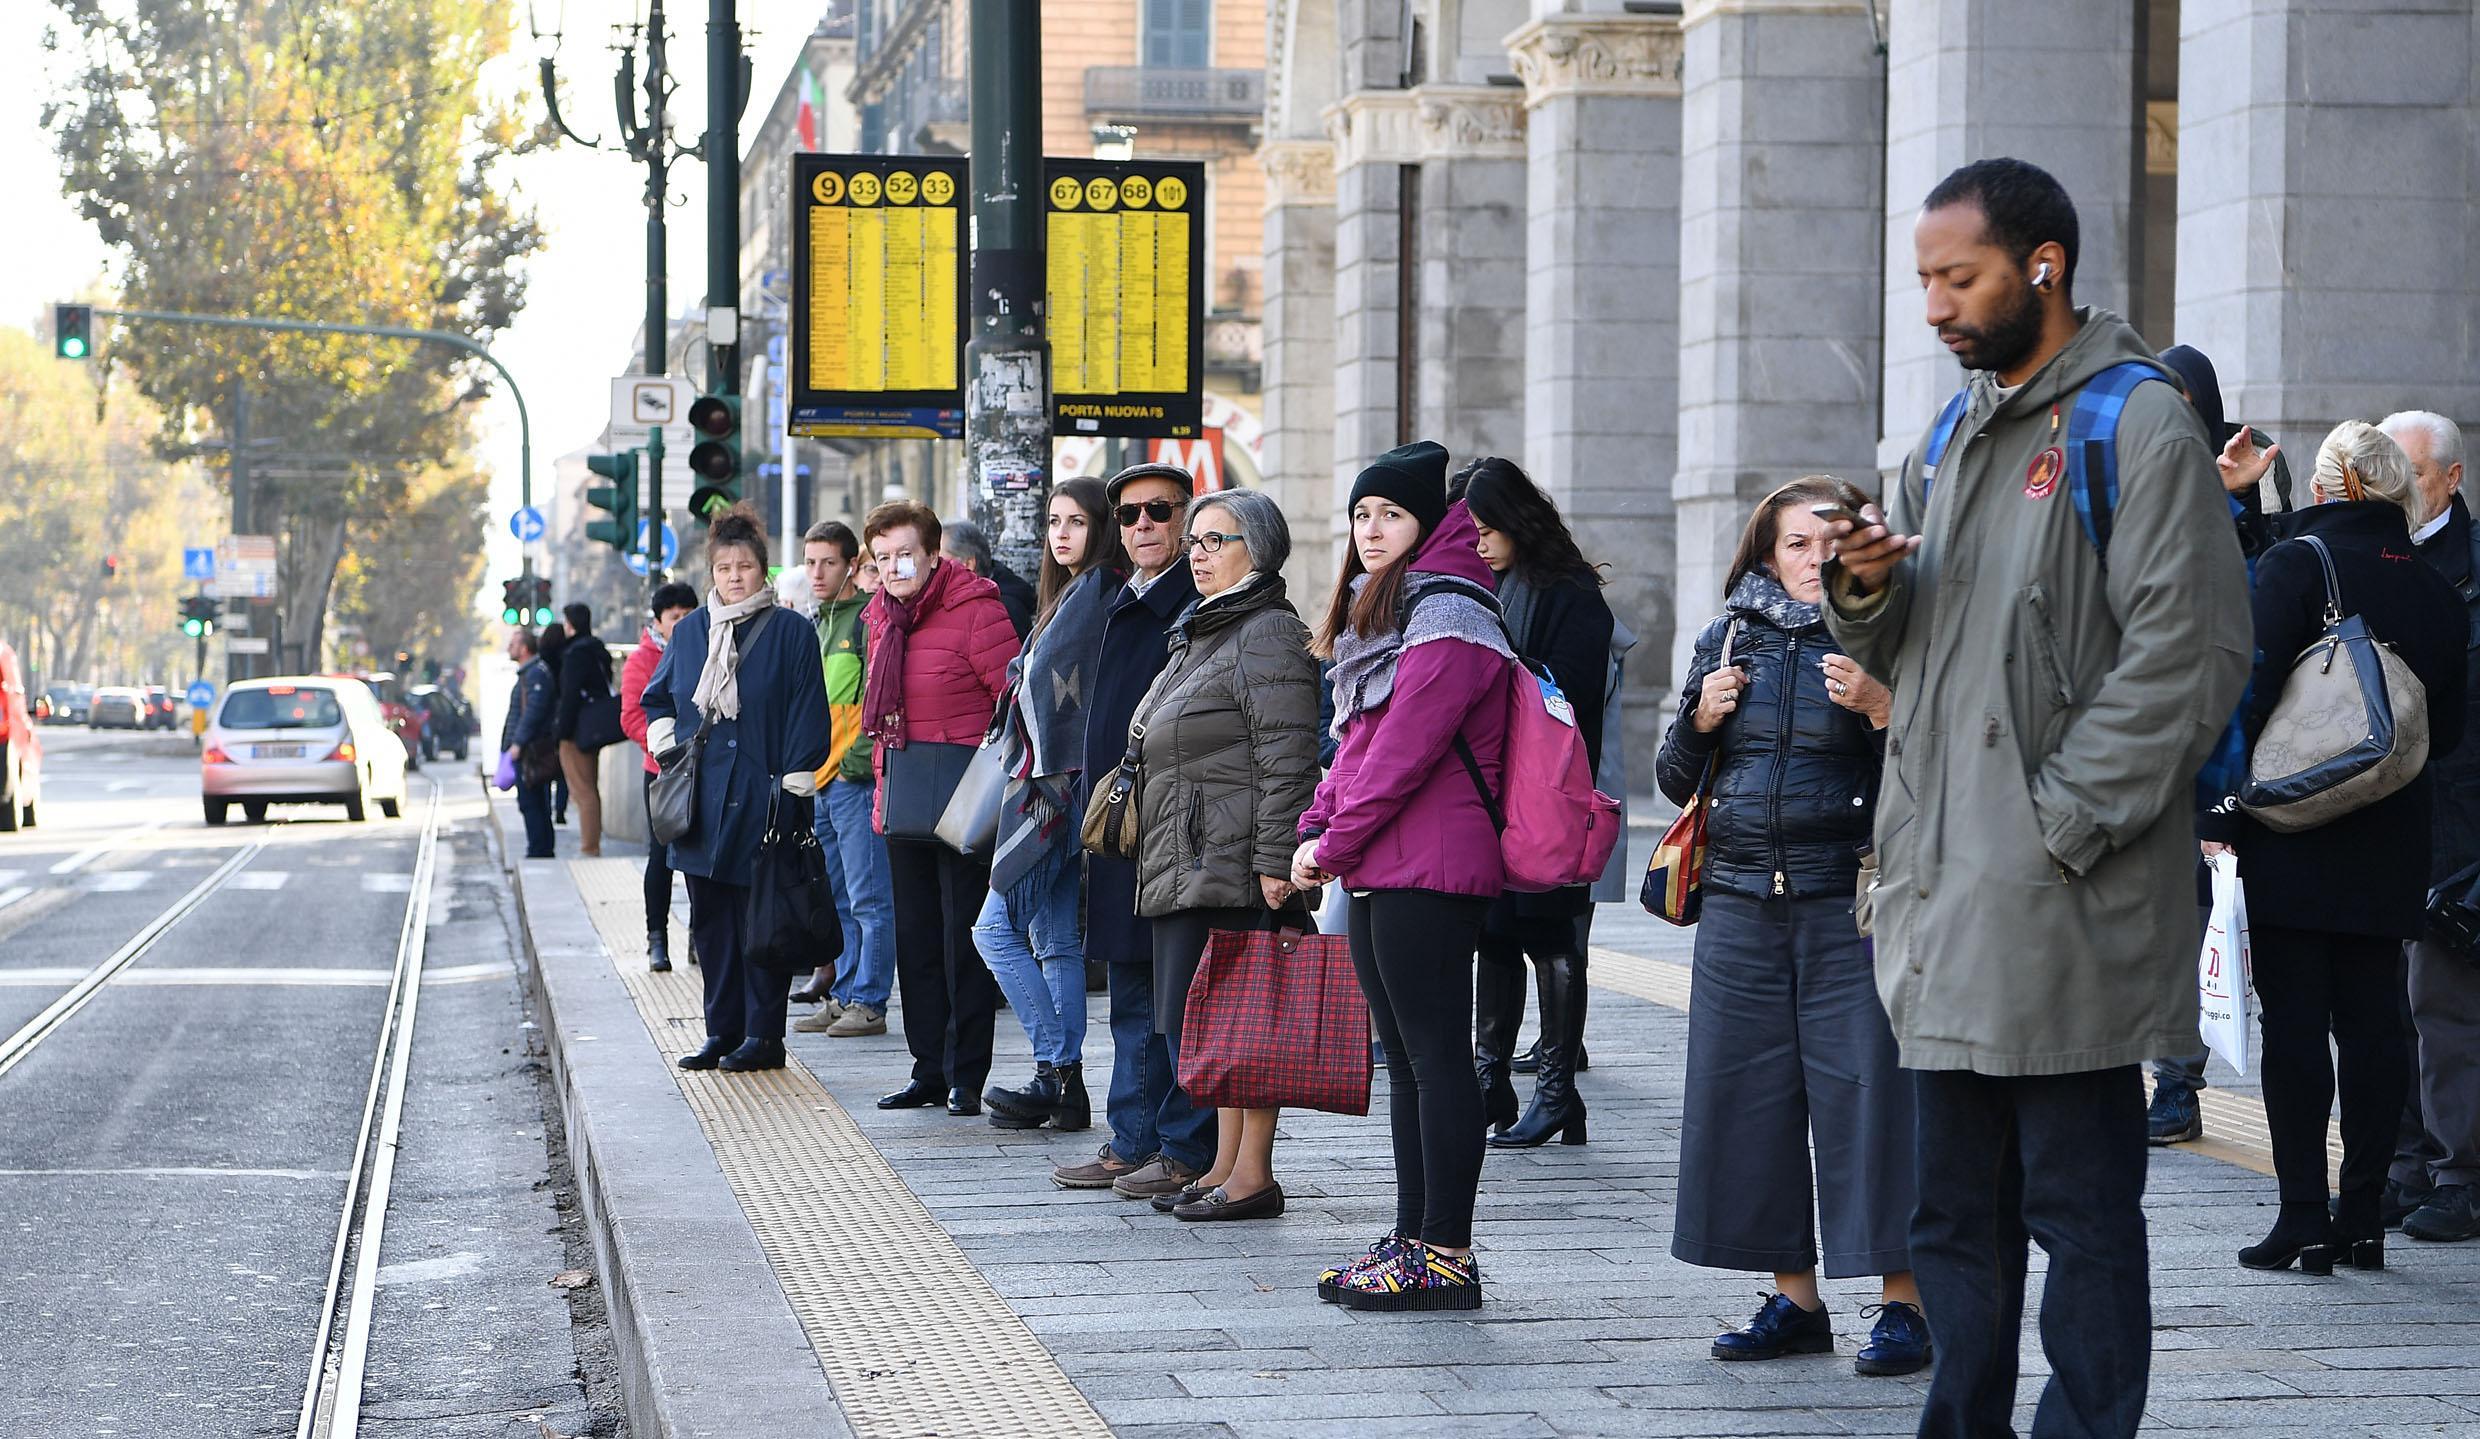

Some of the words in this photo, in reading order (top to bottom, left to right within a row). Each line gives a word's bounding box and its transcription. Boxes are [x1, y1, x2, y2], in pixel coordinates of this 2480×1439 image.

[821, 177, 837, 198] 9
[852, 180, 877, 195] 33
[889, 177, 914, 193] 52
[926, 179, 951, 194] 33
[1055, 184, 1079, 200] 67
[1090, 185, 1114, 200] 67
[1123, 183, 1148, 199] 68
[1162, 185, 1182, 201] 101
[1058, 404, 1103, 417] PORTA
[1104, 405, 1149, 418] NUOVA
[1150, 406, 1165, 419] FS
